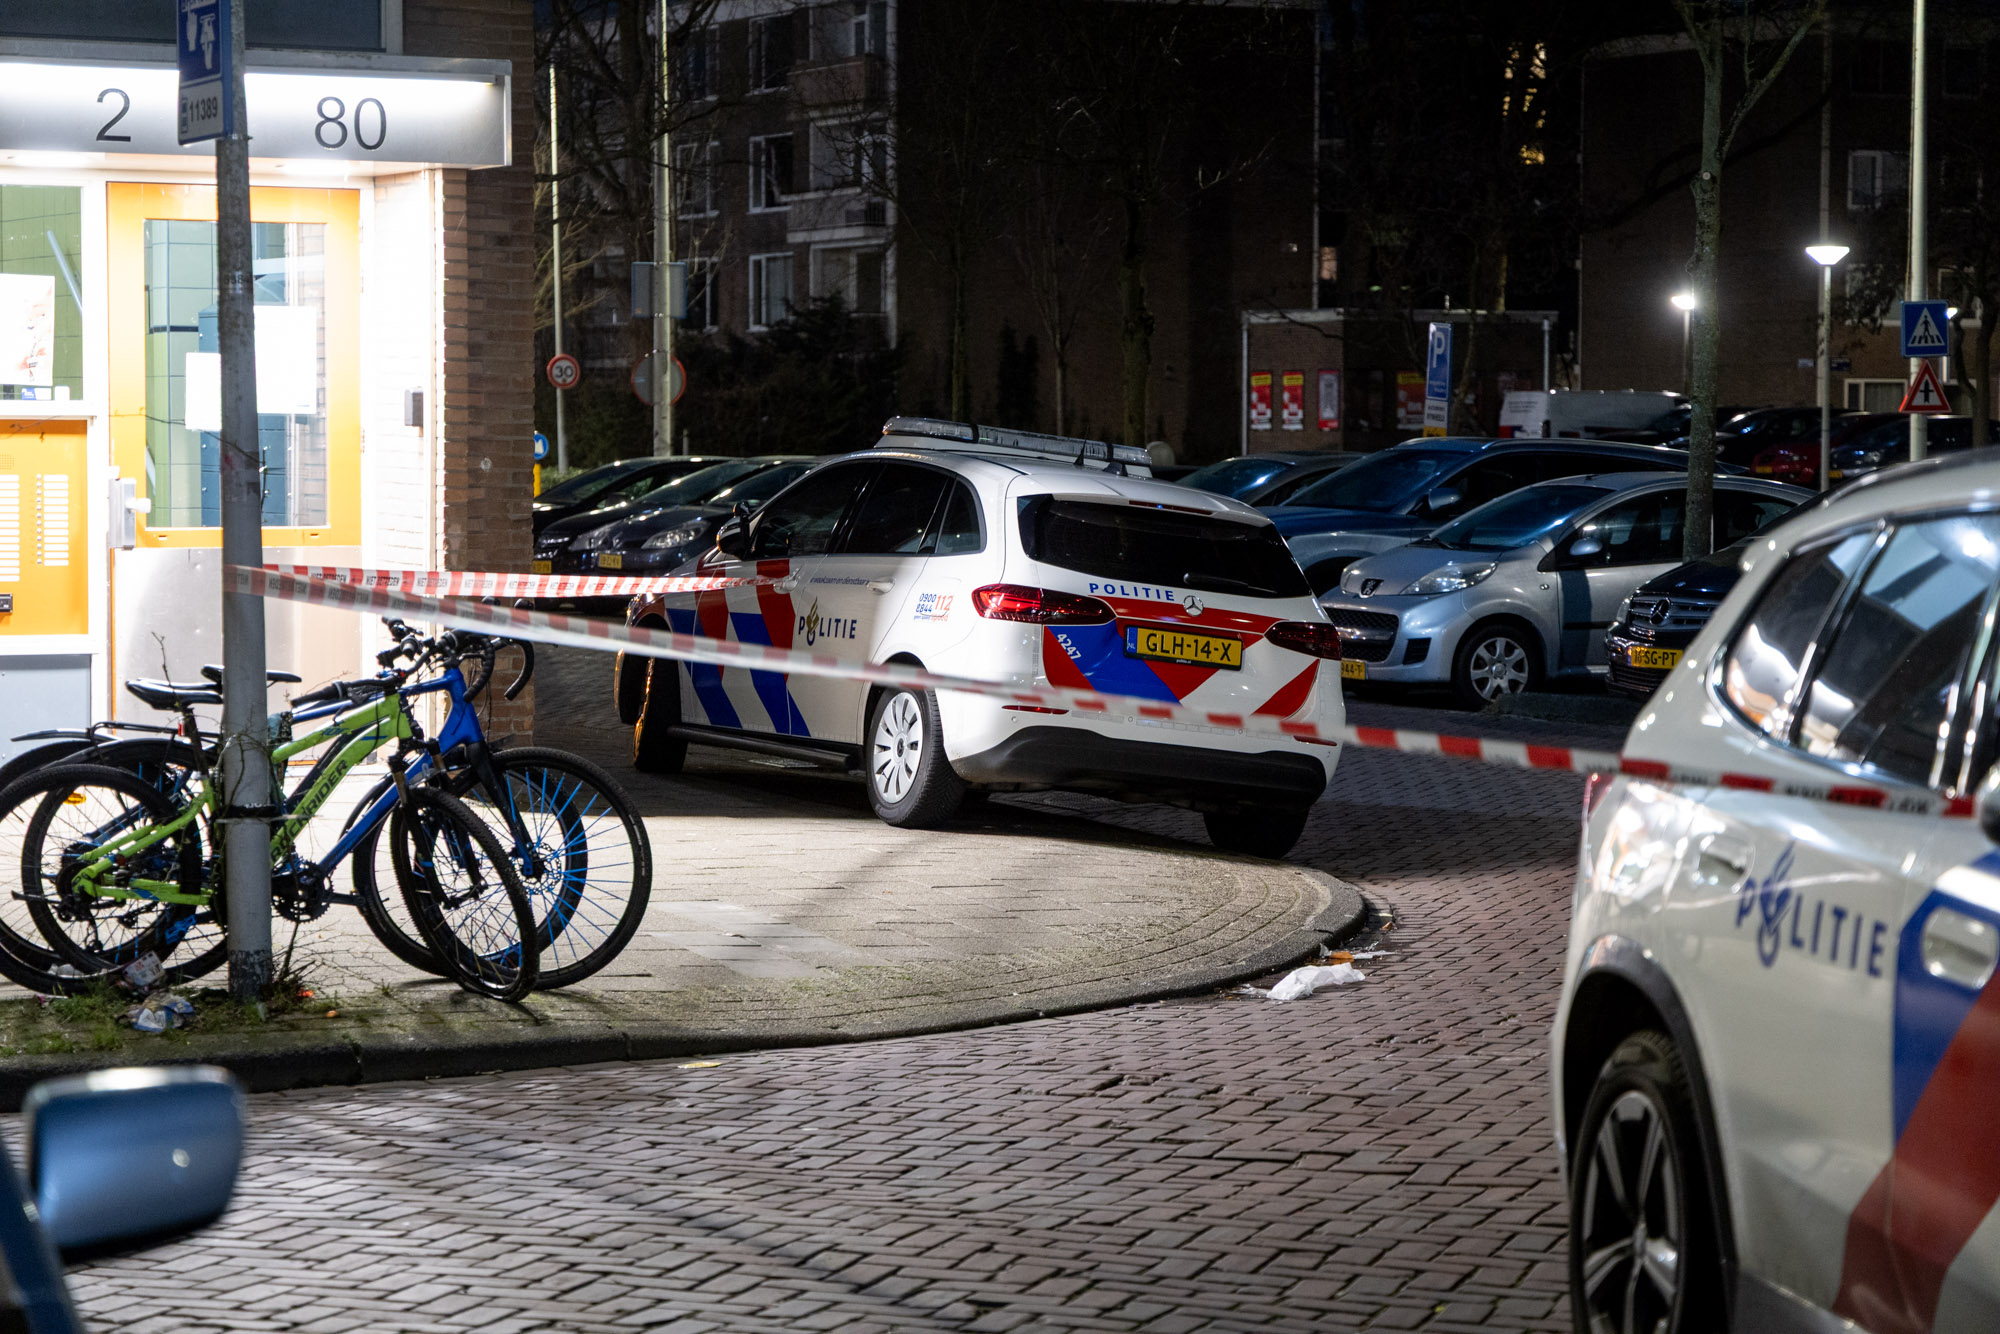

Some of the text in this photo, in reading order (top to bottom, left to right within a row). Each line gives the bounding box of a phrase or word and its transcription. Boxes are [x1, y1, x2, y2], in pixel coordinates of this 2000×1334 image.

[96, 88, 131, 142] 2
[189, 96, 218, 122] 11389
[314, 96, 387, 150] 80
[1432, 331, 1446, 369] P
[555, 365, 574, 378] 30
[919, 593, 937, 603] 0900
[935, 595, 953, 611] 112
[1089, 583, 1175, 601] POLITIE
[916, 603, 932, 613] 8844
[798, 616, 857, 646] POLITIE
[1057, 633, 1082, 660] 4247
[1146, 633, 1232, 662] GLH-14-X
[1735, 875, 1888, 978] POLITIE
